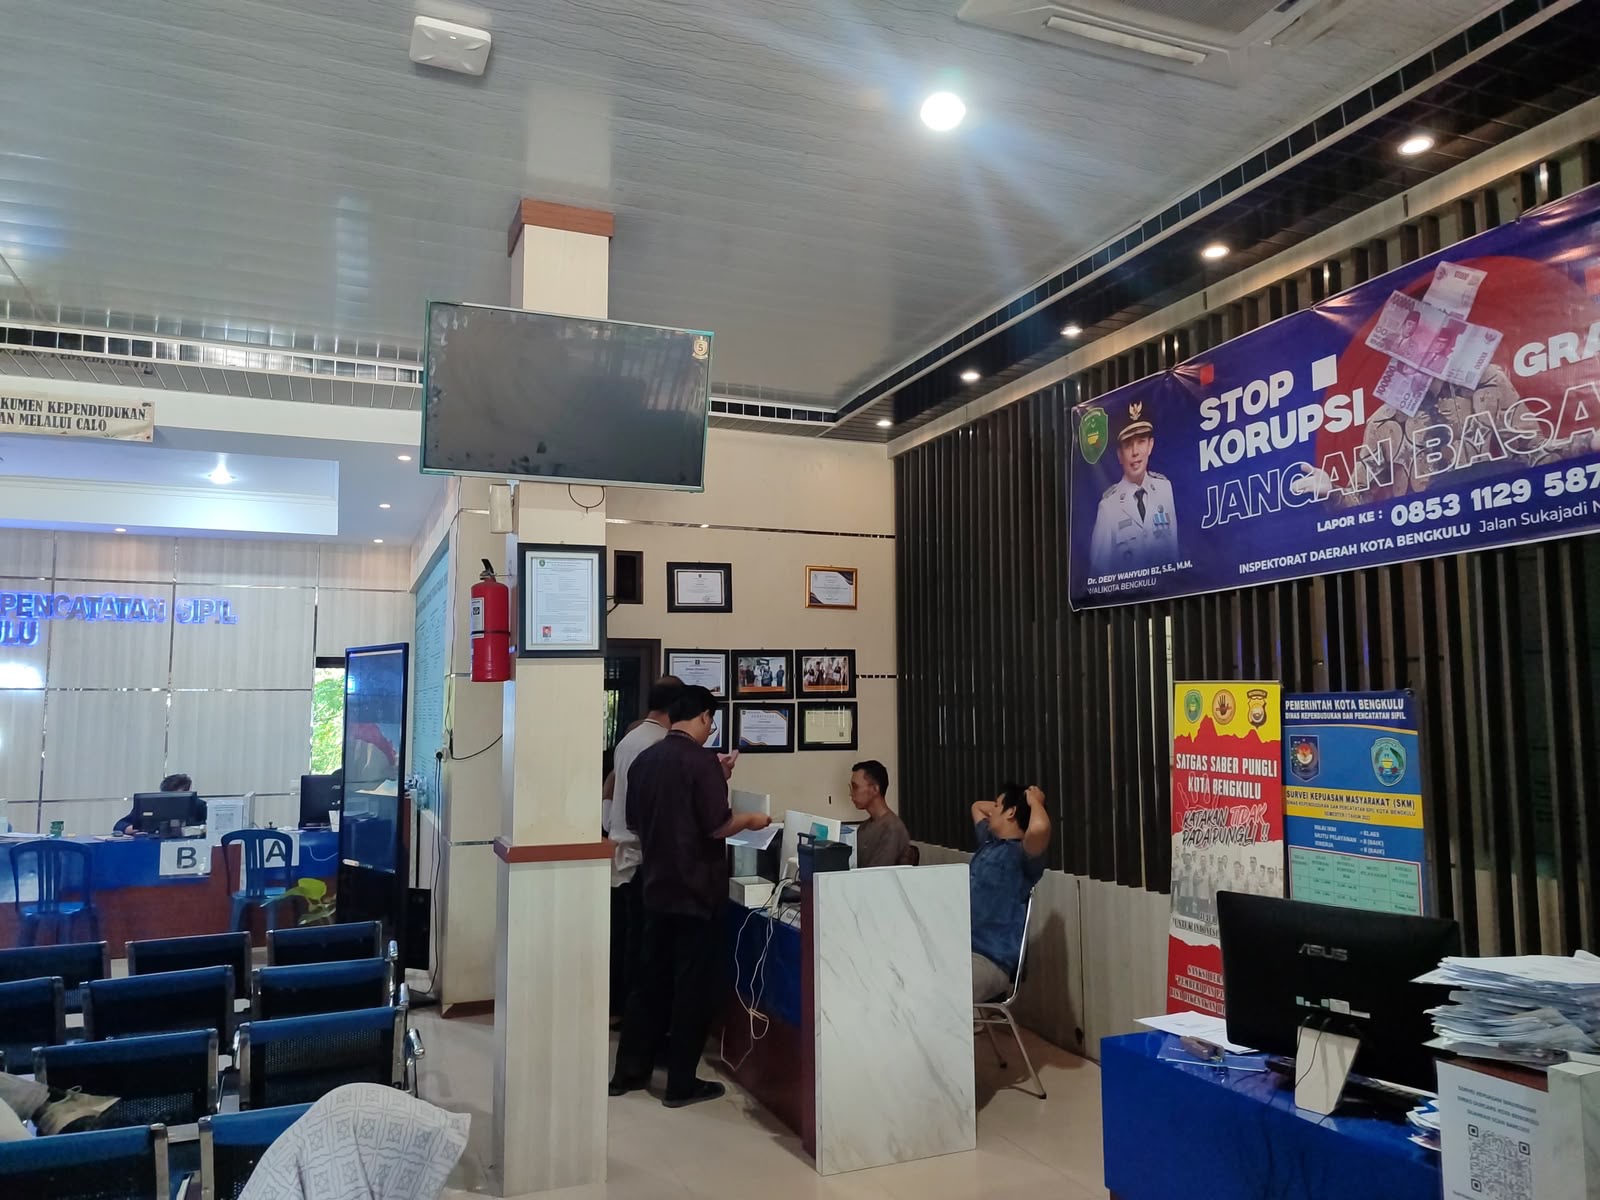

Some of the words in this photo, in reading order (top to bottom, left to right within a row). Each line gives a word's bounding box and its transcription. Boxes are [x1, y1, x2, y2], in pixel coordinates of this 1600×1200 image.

[48, 400, 146, 420] KEPENDUDUKAN
[1200, 370, 1294, 431] STOP
[20, 413, 72, 429] MELALUI
[76, 418, 107, 431] CALO
[1199, 387, 1365, 472] KORUPSI
[1201, 437, 1394, 529] JANGAN
[1317, 515, 1355, 532] LAPOR
[1358, 511, 1375, 524] KE
[1391, 493, 1461, 526] 0853
[1470, 478, 1532, 511] 1129
[1239, 552, 1308, 574] INSPEKTORAT
[1310, 544, 1357, 562] DAERAH
[1360, 537, 1394, 553] KOTA
[1396, 523, 1471, 547] BENGKULU
[1479, 516, 1517, 533] Jalan
[1520, 501, 1588, 525] Sukajadi
[1087, 577, 1098, 585] Dr.
[1098, 574, 1117, 584] DEDY
[1117, 567, 1150, 580] WAHYUDI
[1176, 559, 1193, 571] M.M.
[1087, 583, 1120, 595] WALIKOTA
[1120, 577, 1157, 591] BENGKULU
[0, 592, 167, 622] PENCATATAN
[176, 599, 238, 625] SIPIL
[0, 620, 39, 646] LU
[1285, 700, 1332, 710] PEMERINTAH
[1334, 699, 1357, 710] KOTA
[1358, 698, 1404, 710] BENGKULU
[1354, 712, 1390, 720] PENCATATAN
[1176, 753, 1208, 771] SATGAS
[1210, 756, 1239, 774] SABER
[1242, 758, 1277, 777] PUNGLI
[1188, 775, 1210, 794] KOTA
[1212, 778, 1261, 800] BENGKULU
[1286, 790, 1308, 800] SURVEI
[1310, 792, 1344, 803] KEPUASAN
[1345, 795, 1390, 807] MASYARAKAT
[1393, 799, 1415, 810] (SKM)
[1182, 806, 1229, 828] KATAKAN
[1230, 802, 1267, 827] TIDAK
[177, 847, 197, 869] B
[265, 841, 286, 863] A
[1299, 943, 1348, 961] ASUS
